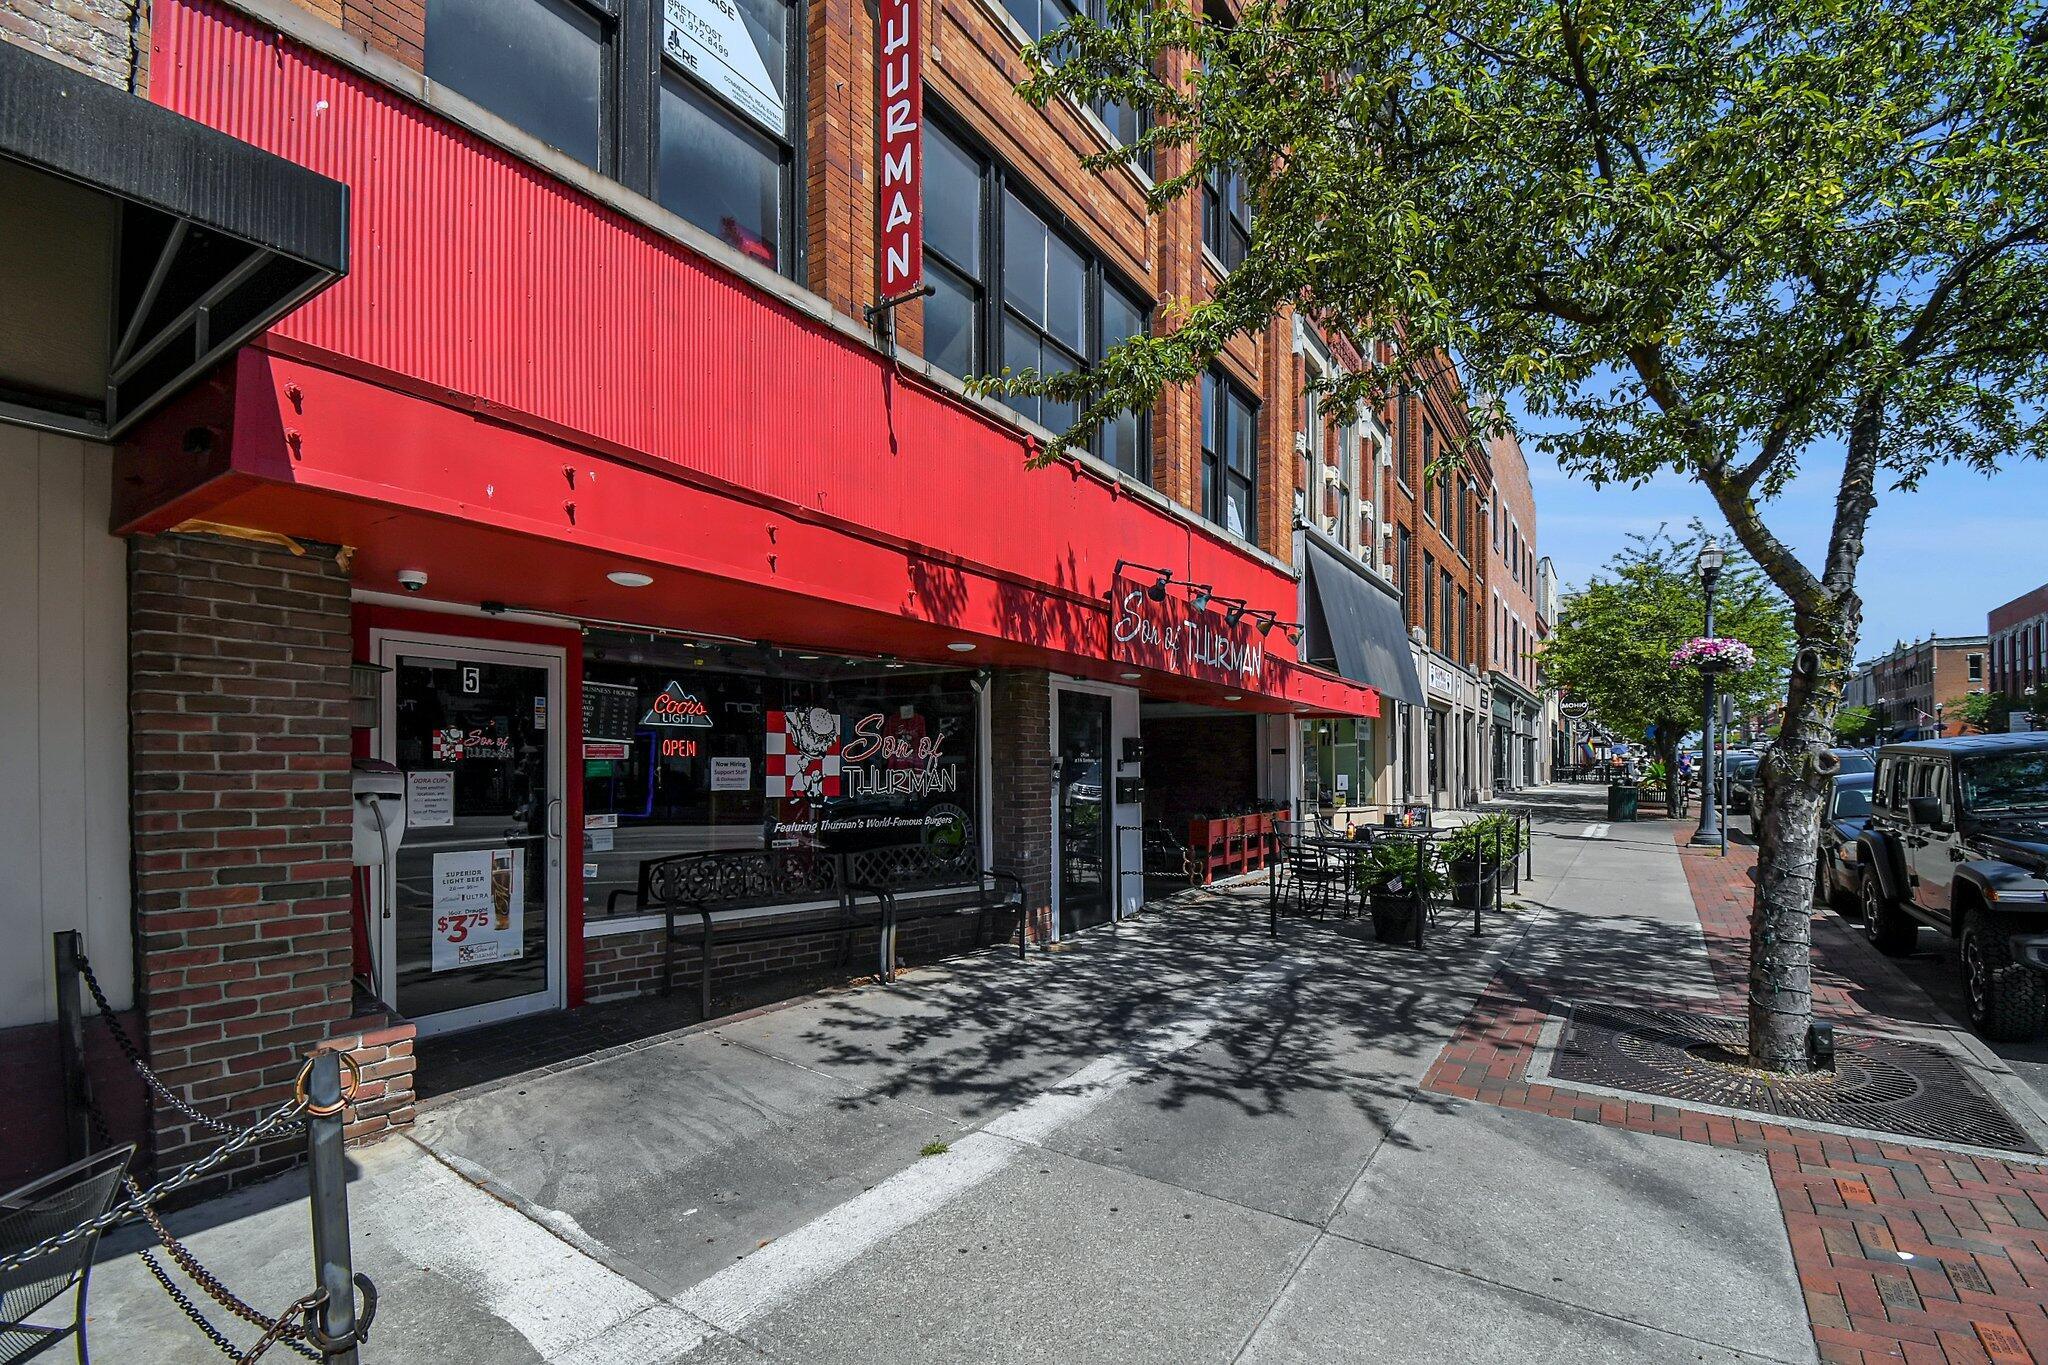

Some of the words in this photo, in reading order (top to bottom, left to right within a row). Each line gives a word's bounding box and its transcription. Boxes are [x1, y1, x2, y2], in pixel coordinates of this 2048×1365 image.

[699, 19, 722, 42] POST
[884, 0, 917, 283] HURMAN
[1114, 591, 1161, 646] Son
[1165, 624, 1182, 671] of
[1183, 620, 1262, 679] THURMAN
[465, 668, 478, 691] 5
[654, 693, 708, 715] Coors
[662, 713, 695, 724] LIGHT
[464, 729, 495, 747] Son
[497, 736, 510, 751] of
[662, 739, 697, 757] OPEN
[841, 713, 914, 763] Son
[918, 732, 946, 776] of
[841, 763, 957, 799] THURMAN
[774, 820, 817, 834] Featuring
[821, 819, 864, 831] Thurman's
[866, 816, 923, 829] World-Famous
[924, 815, 953, 827] Burgers
[445, 870, 482, 878] SUPERIOR
